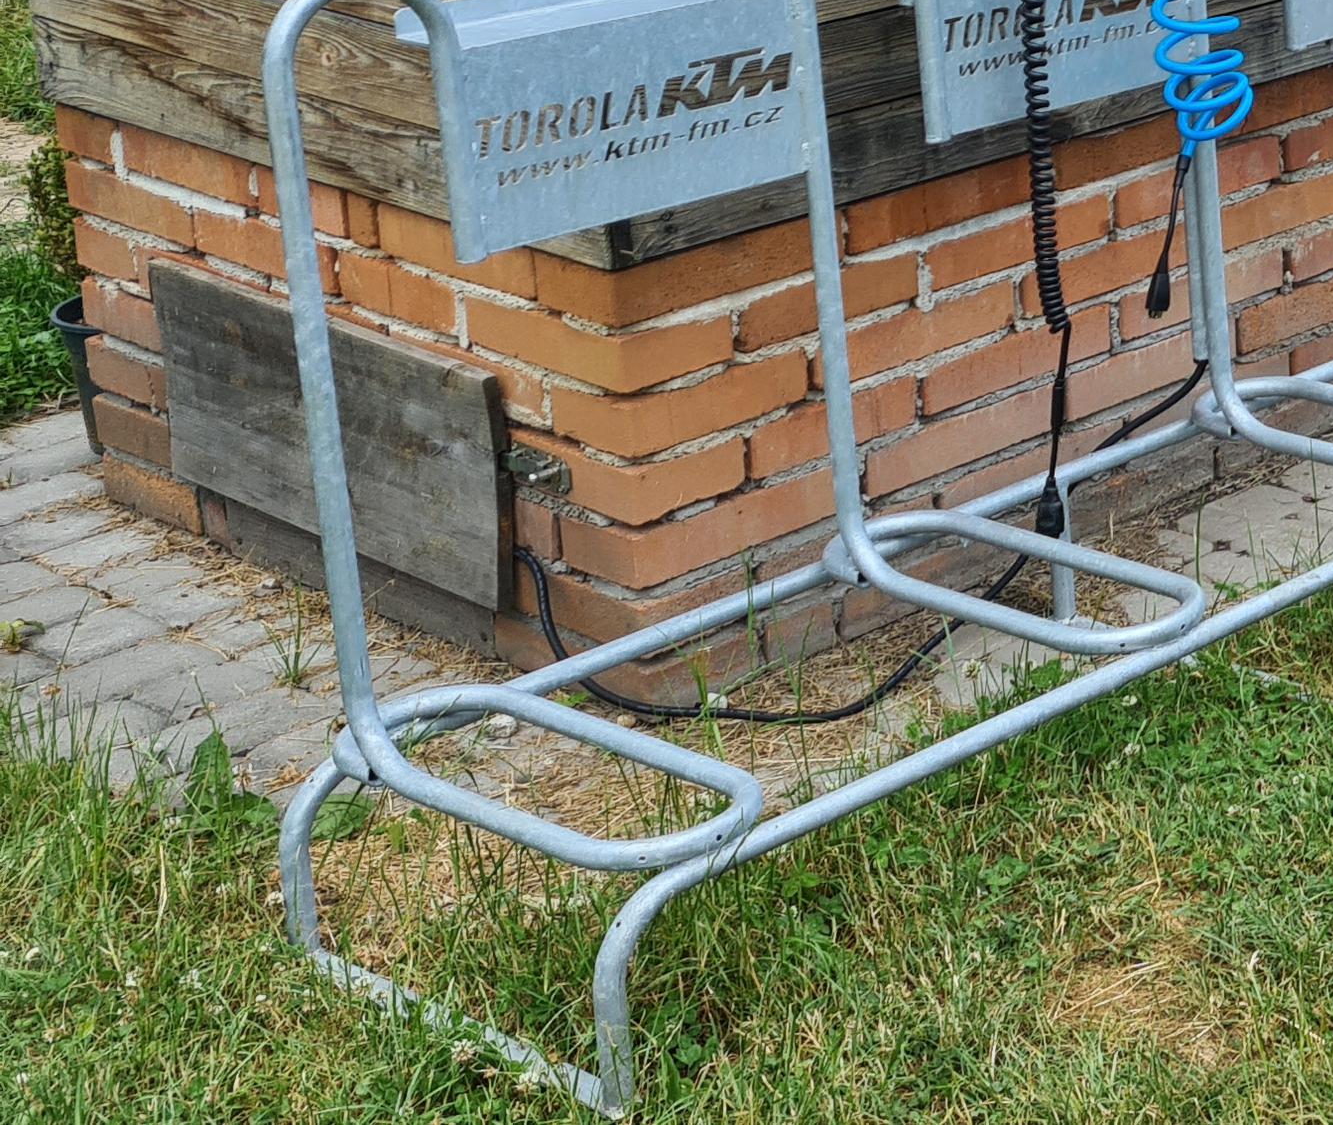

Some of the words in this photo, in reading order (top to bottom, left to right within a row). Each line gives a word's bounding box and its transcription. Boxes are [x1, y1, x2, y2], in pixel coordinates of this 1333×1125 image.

[474, 83, 650, 160] TOROLA
[655, 46, 793, 119] KTM
[497, 105, 786, 188] www.ktm-fm.cz
